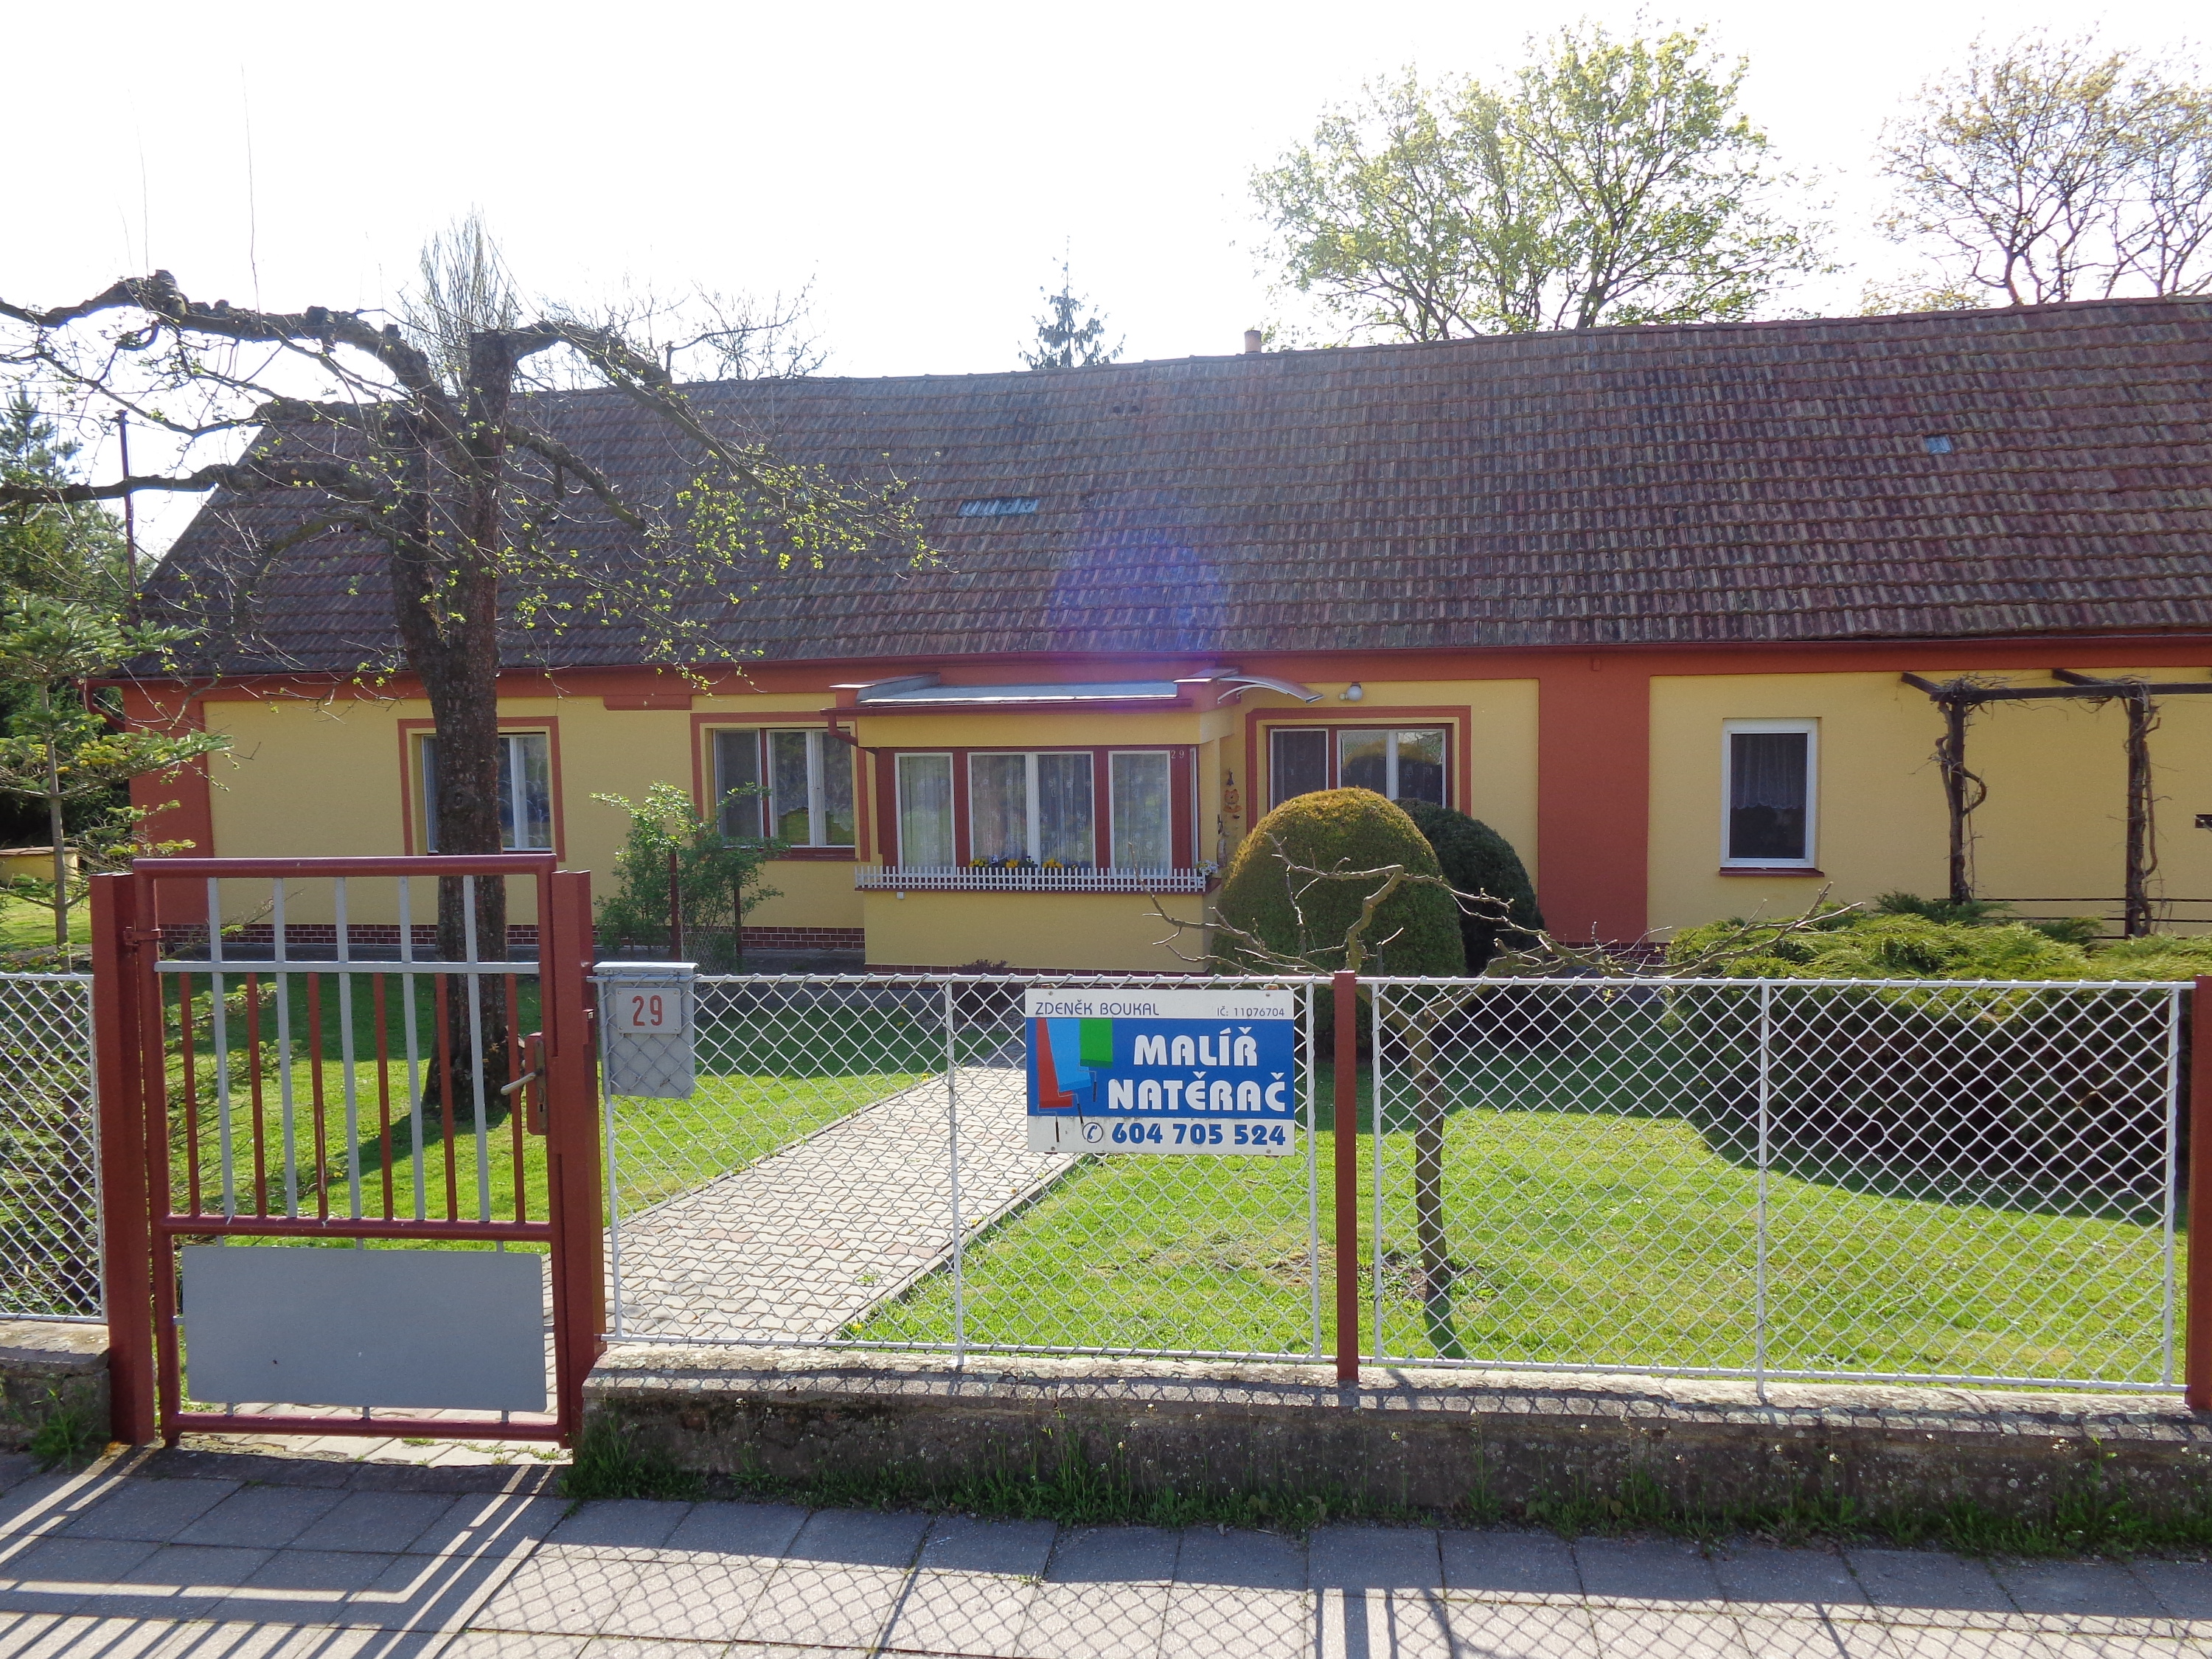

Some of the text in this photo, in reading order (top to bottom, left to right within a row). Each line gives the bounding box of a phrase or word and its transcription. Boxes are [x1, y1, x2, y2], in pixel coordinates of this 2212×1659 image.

[1171, 750, 1184, 759] 29
[632, 995, 663, 1026] 29
[1035, 999, 1160, 1016] ZDENĚK BOUKAL
[1217, 1006, 1285, 1017] IČ: 11076704
[1133, 1026, 1258, 1066] MALÍŘ
[1107, 1071, 1286, 1112] NATĚRAČ
[1111, 1122, 1286, 1146] 604 705 524
